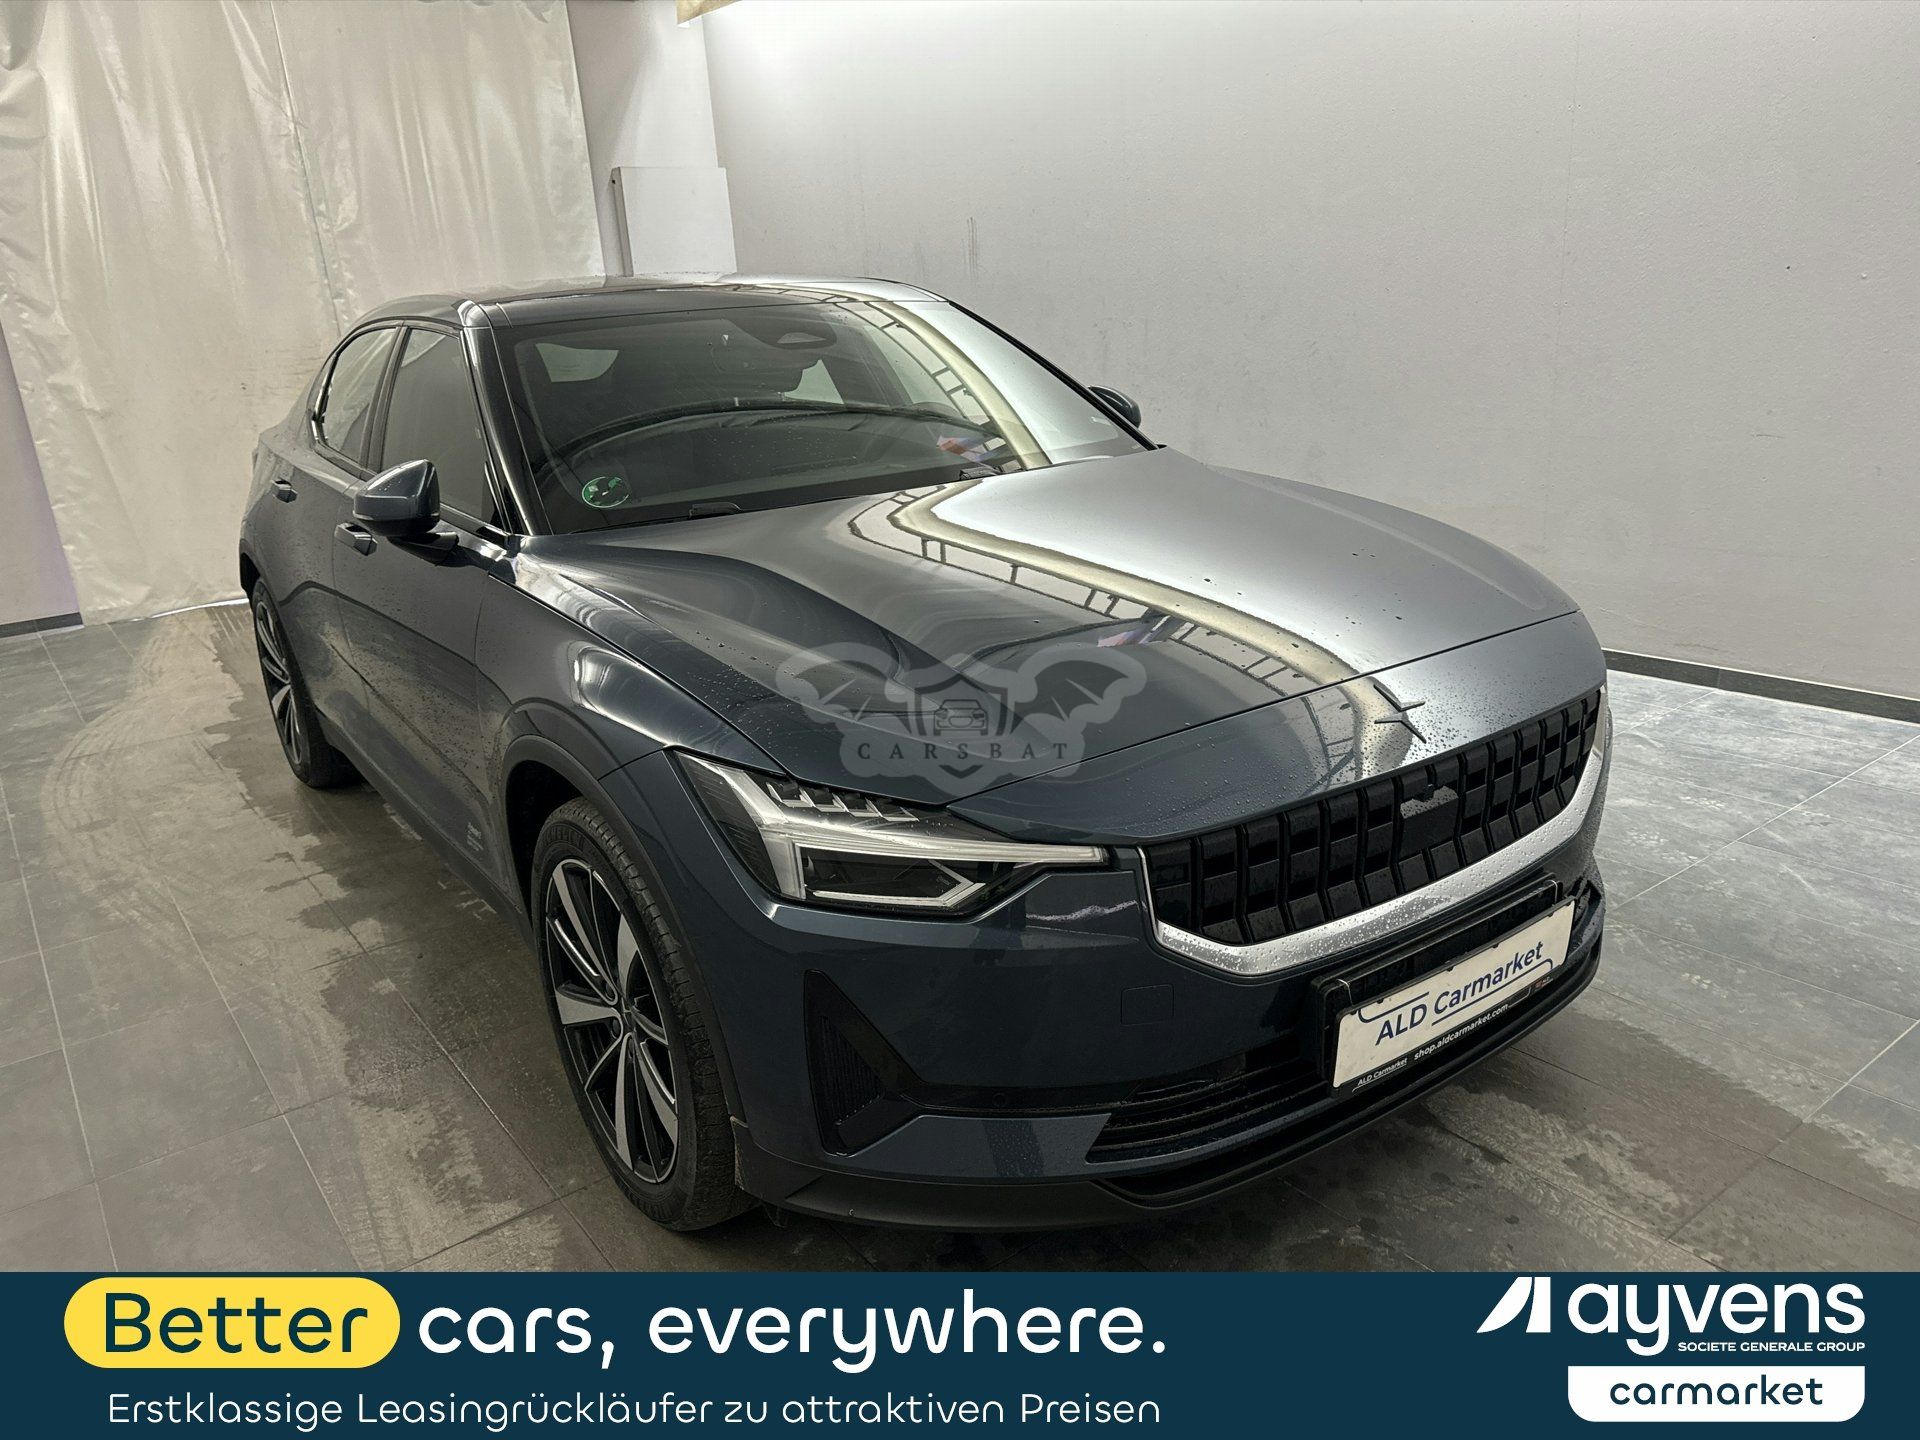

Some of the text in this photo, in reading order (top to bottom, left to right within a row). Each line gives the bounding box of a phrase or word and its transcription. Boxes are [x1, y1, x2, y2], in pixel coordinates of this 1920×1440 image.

[1375, 941, 1543, 1046] ALD Carmarket
[1414, 1003, 1509, 1061] shop.aldcarmarket.com
[1357, 1057, 1408, 1087] ALD Carmarket
